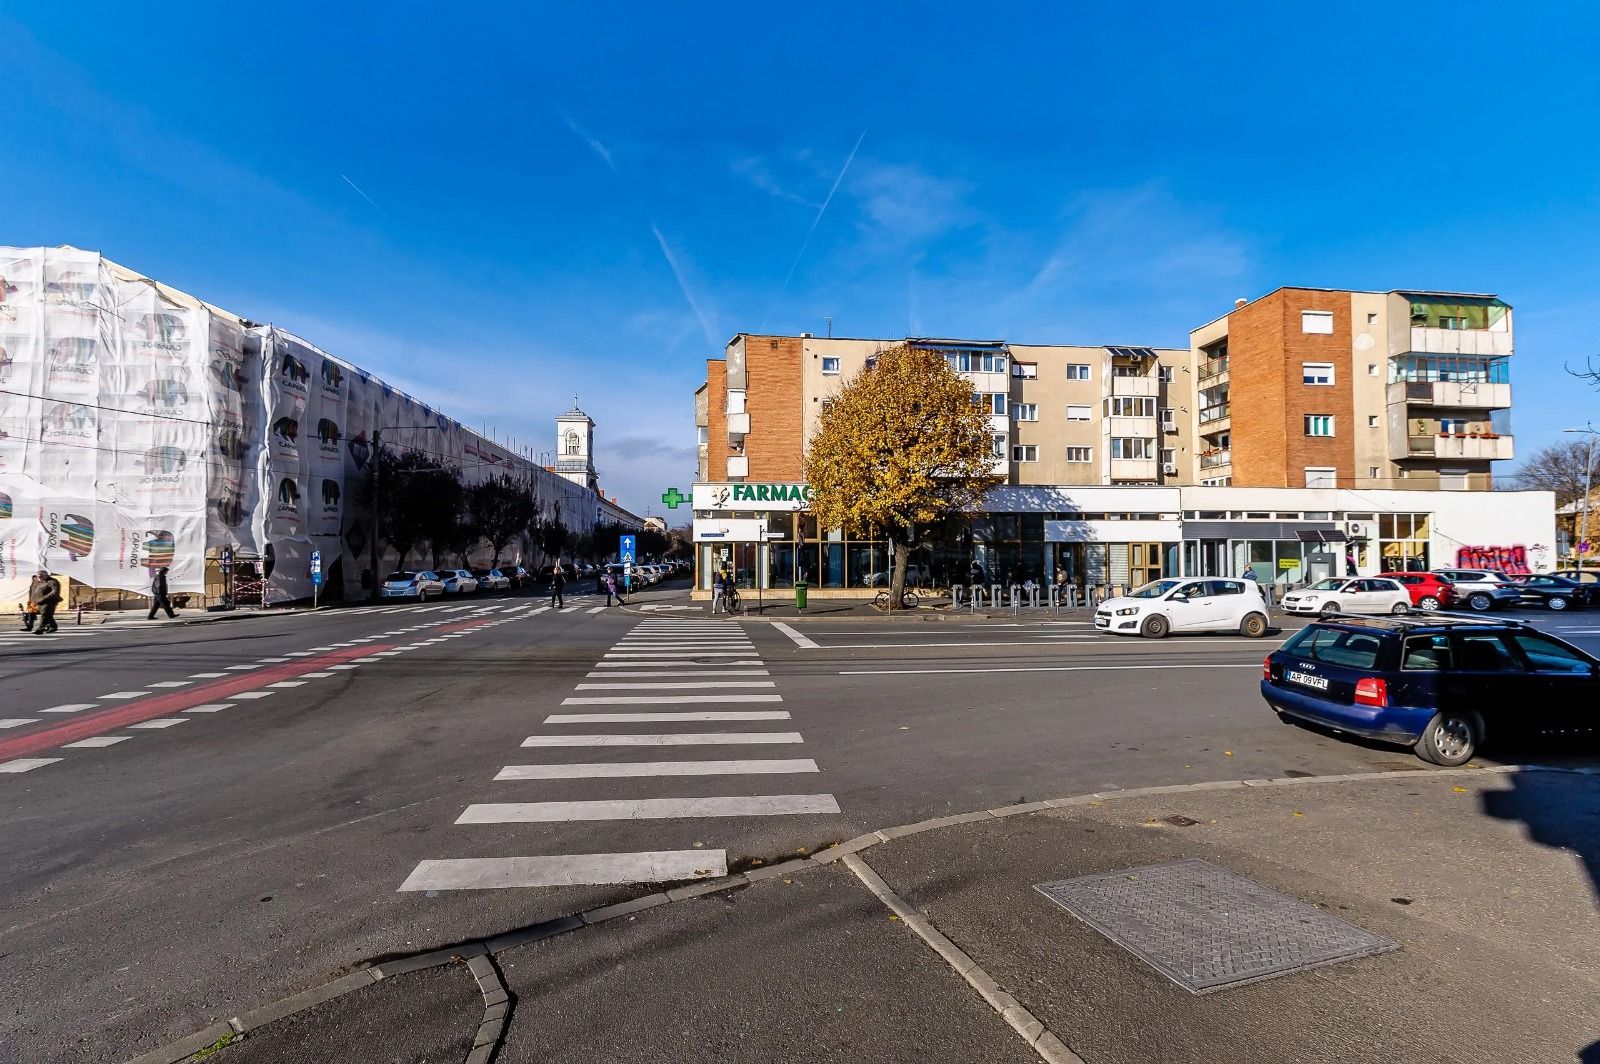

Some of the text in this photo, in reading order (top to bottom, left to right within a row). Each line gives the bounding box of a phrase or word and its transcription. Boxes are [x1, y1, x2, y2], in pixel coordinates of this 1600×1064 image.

[48, 512, 58, 549] CAPAROL
[130, 532, 140, 569] CAPAROL
[1291, 673, 1301, 682] AR
